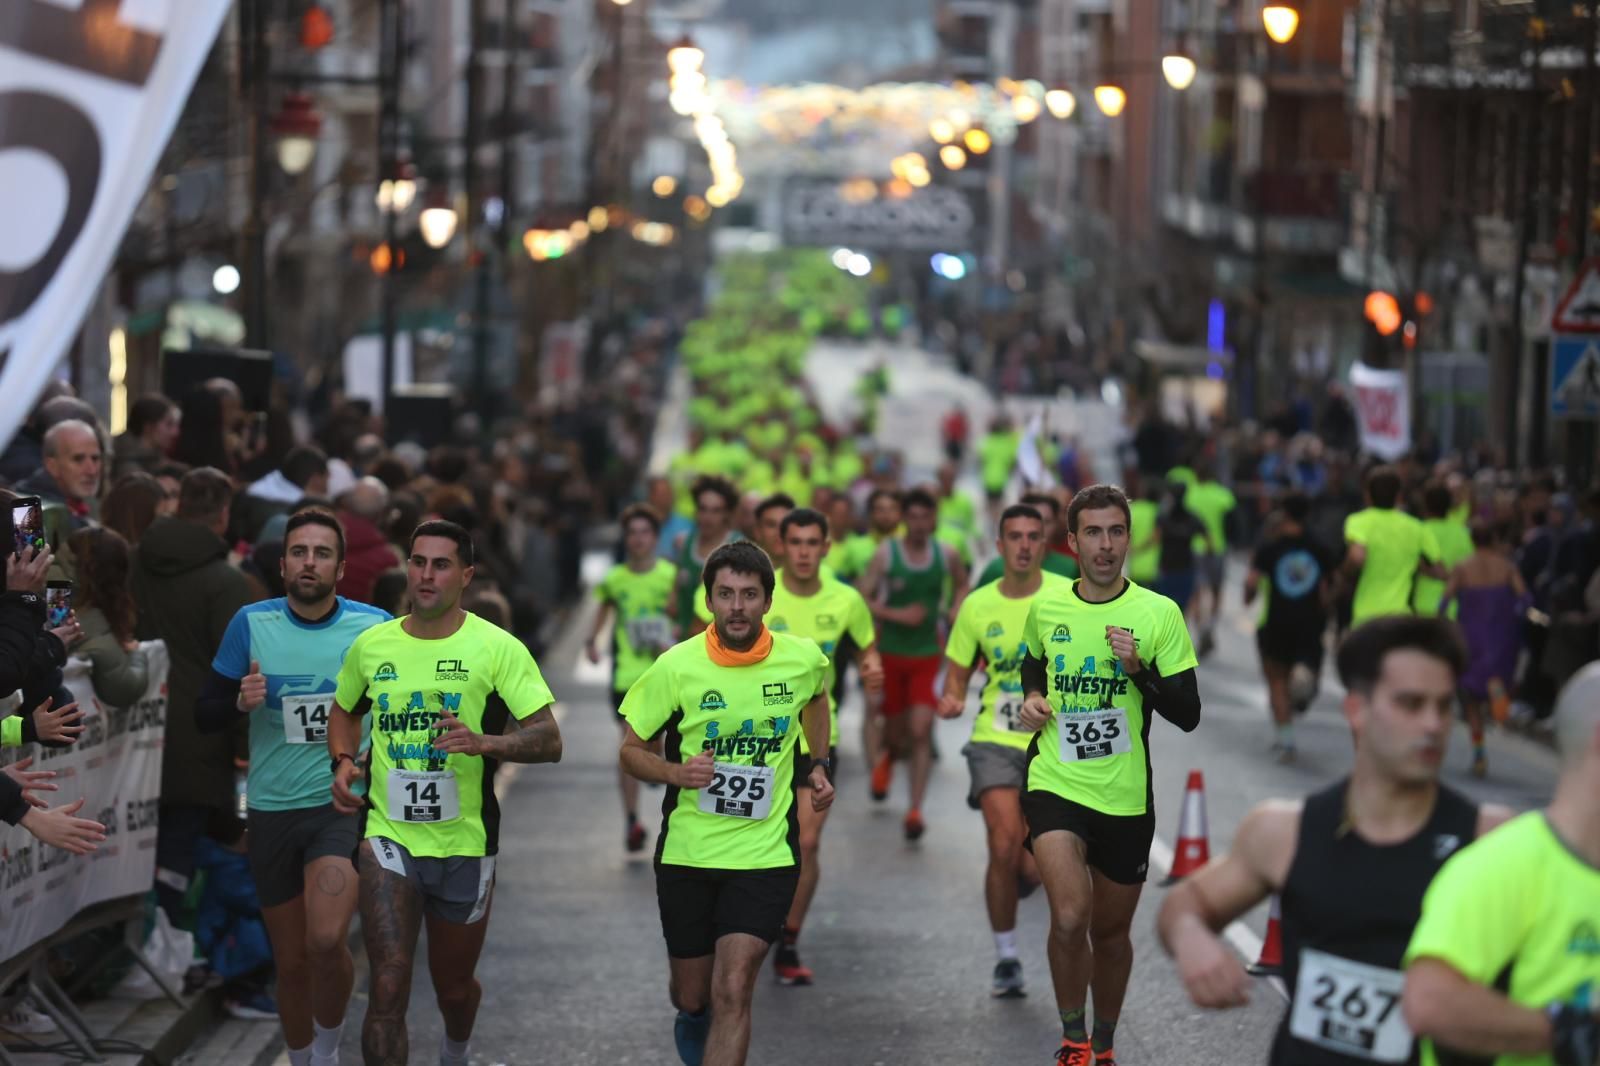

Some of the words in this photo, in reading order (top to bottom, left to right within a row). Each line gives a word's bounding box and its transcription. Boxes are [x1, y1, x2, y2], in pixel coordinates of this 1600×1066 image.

[1054, 674, 1128, 695] SILVESTRE
[378, 711, 460, 732] SILVEST
[1064, 718, 1121, 745] 363
[404, 781, 440, 805] 14
[706, 772, 766, 801] 295
[1312, 974, 1402, 1026] 267
